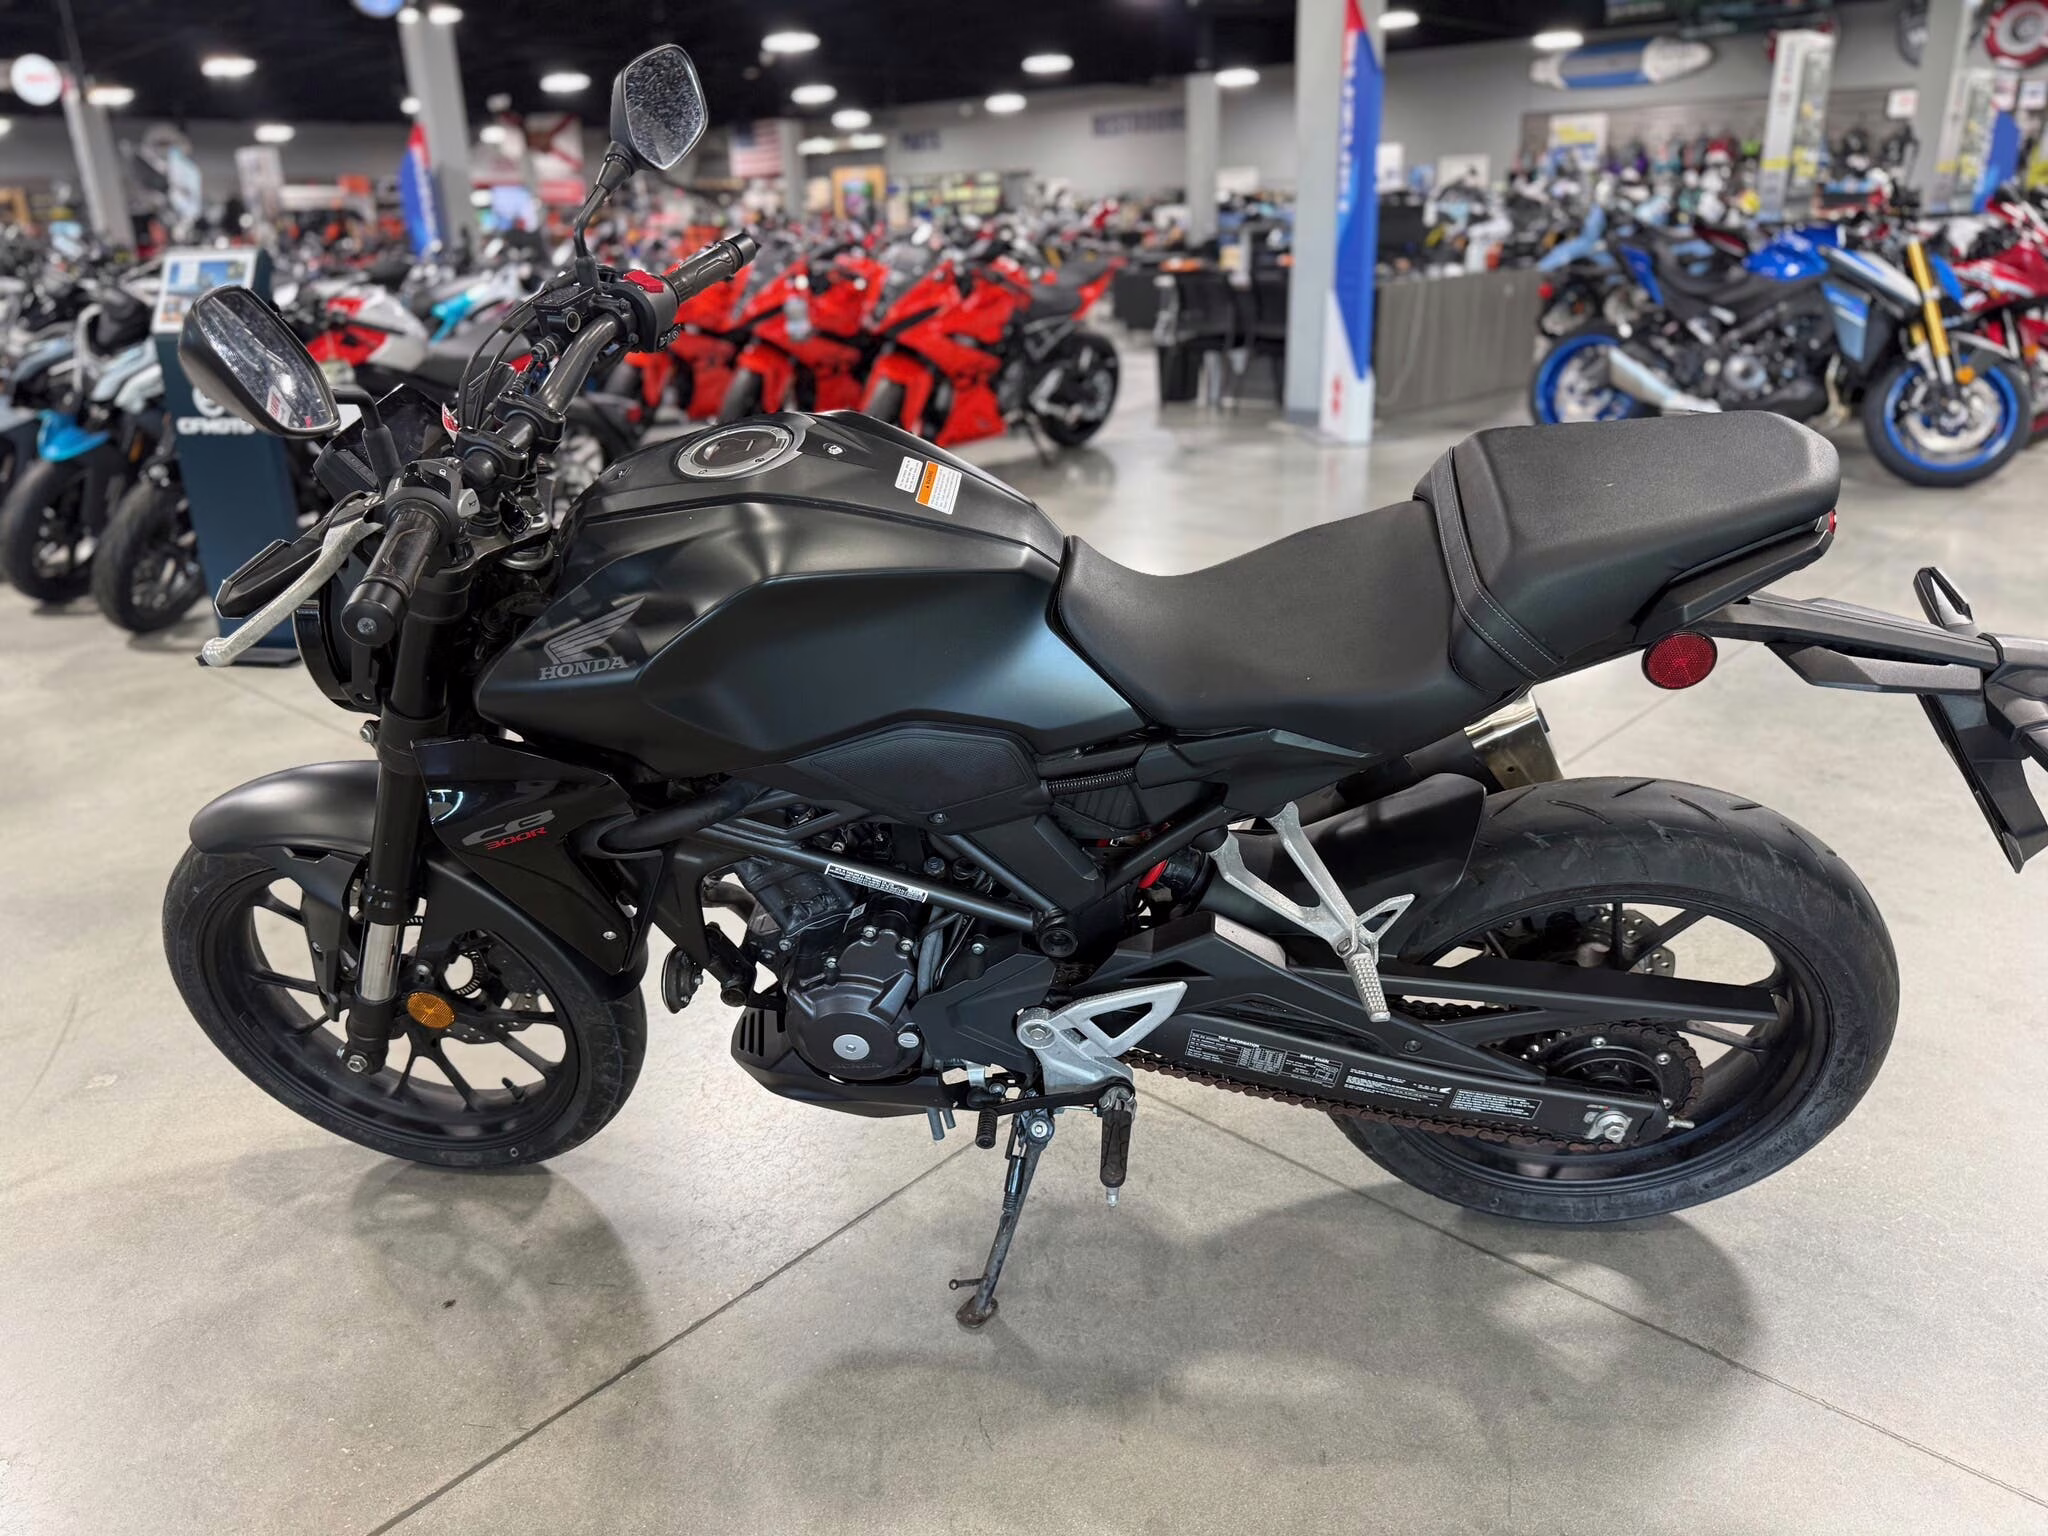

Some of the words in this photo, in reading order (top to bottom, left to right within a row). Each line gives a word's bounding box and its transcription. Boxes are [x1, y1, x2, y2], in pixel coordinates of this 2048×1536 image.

[539, 656, 629, 680] HONDA
[462, 809, 555, 846] CB
[484, 827, 548, 850] 300R
